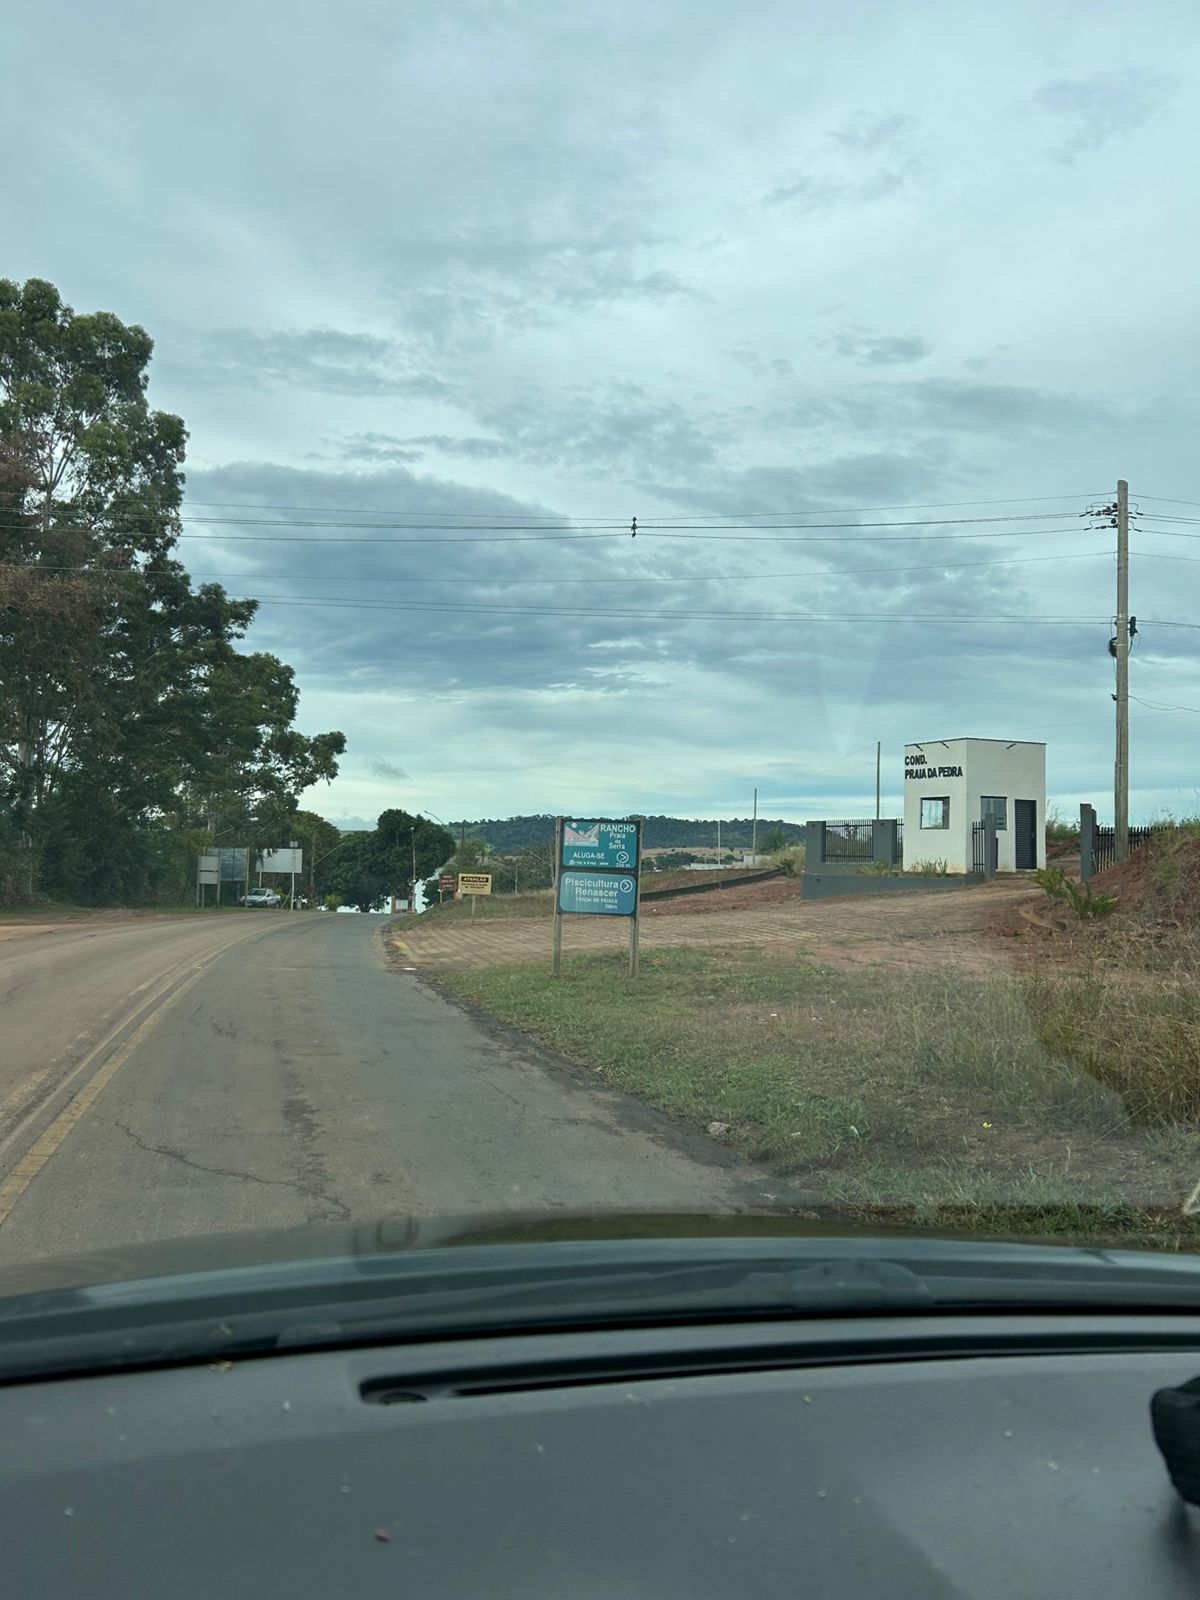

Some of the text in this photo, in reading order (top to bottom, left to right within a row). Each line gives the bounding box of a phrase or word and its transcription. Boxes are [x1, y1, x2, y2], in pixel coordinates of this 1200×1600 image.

[904, 755, 927, 765] COND.
[905, 766, 963, 779] PRAIA DA PEDRA
[600, 824, 635, 833] RANCHO
[565, 878, 618, 888] Piscicultura
[576, 887, 618, 897] Renascer
